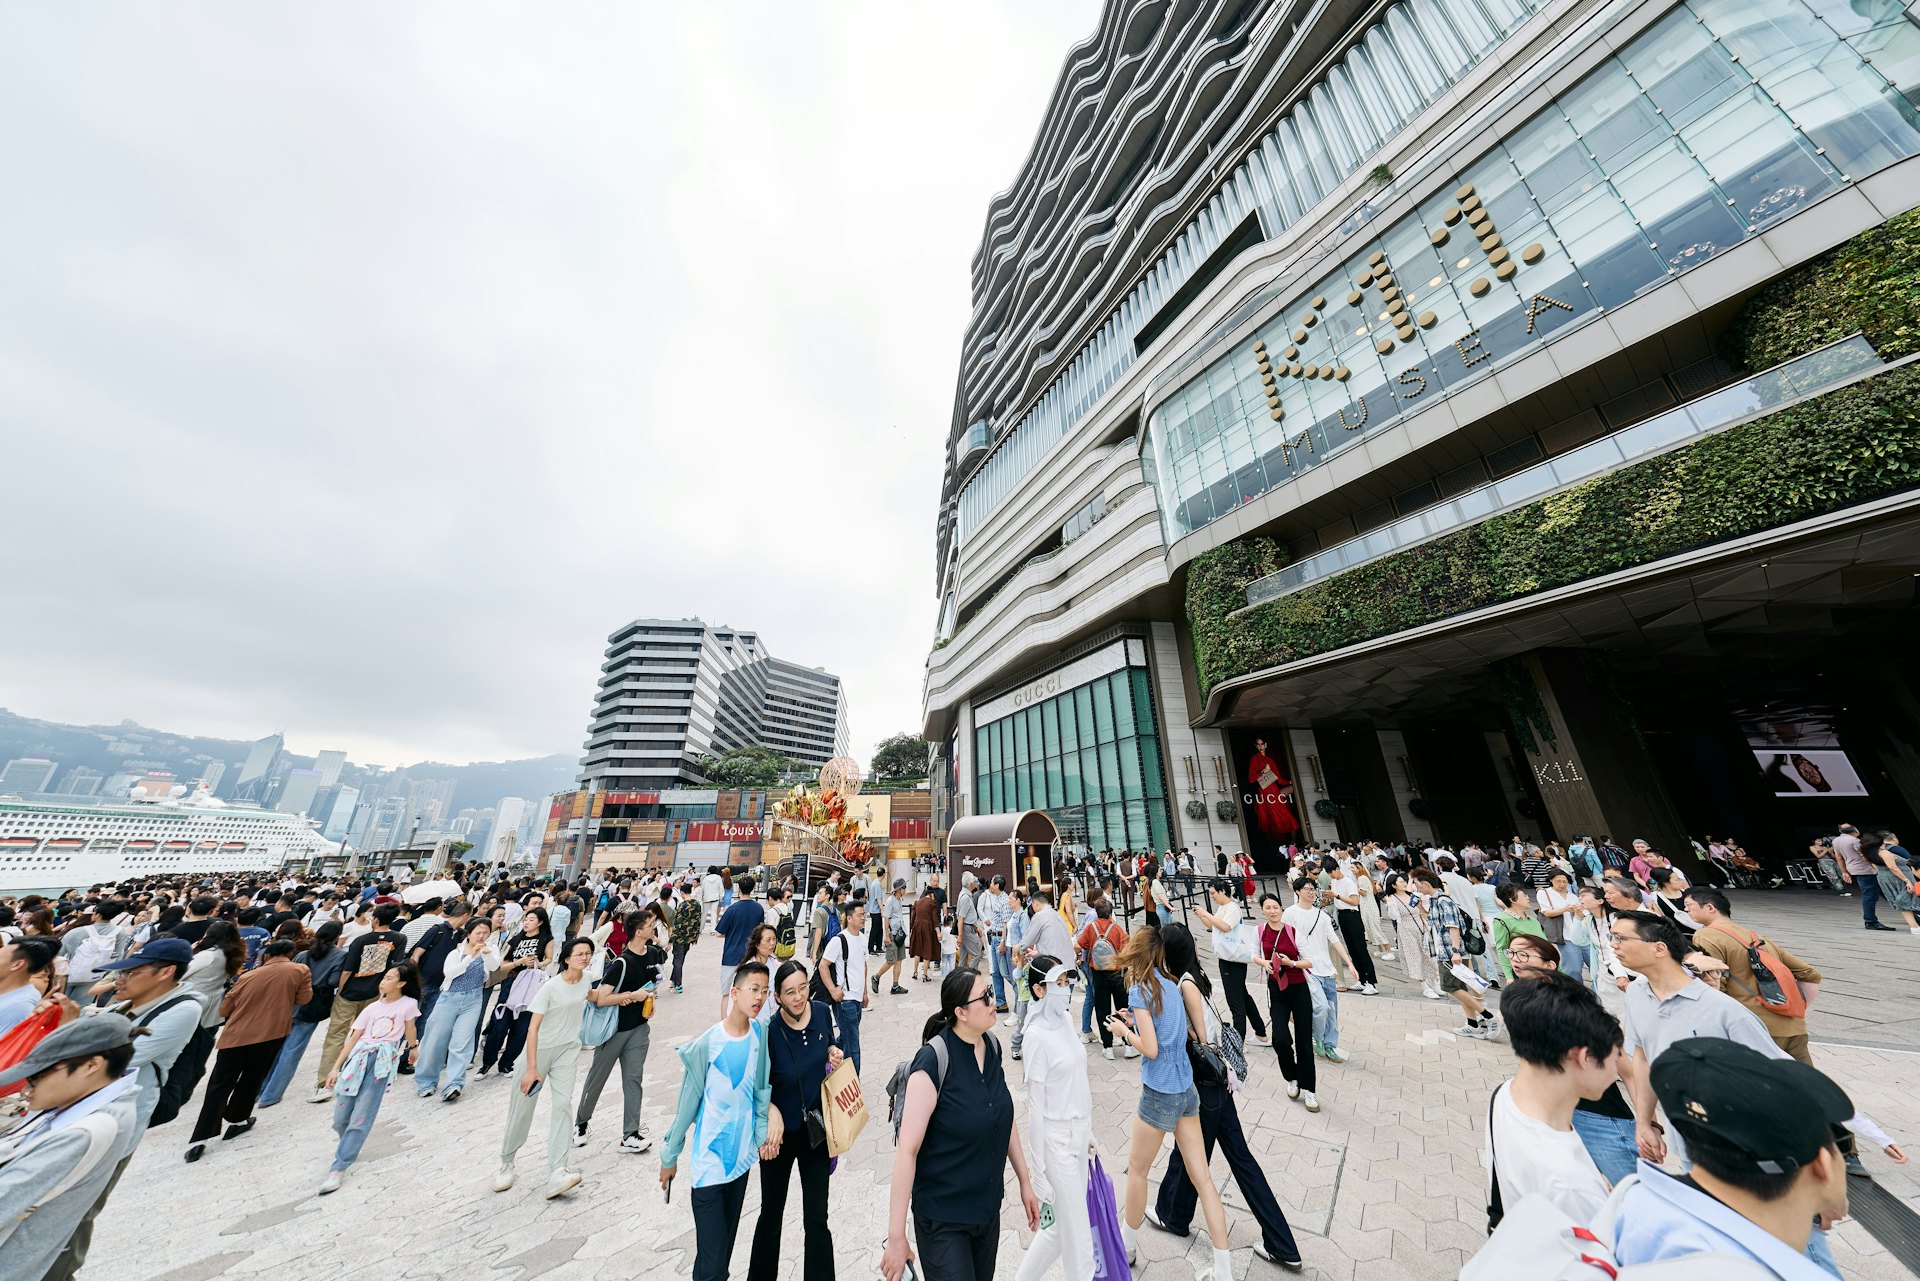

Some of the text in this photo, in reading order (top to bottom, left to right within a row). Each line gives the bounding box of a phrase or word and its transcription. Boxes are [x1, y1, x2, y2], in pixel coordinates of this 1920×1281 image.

[1253, 183, 1546, 422] K11
[1280, 293, 1574, 467] MUSEA
[1013, 674, 1063, 707] GUCCI
[1533, 760, 1583, 785] K11
[1243, 793, 1294, 805] GUCCI
[724, 827, 754, 836] LOUIS
[834, 1078, 862, 1112] MUJI
